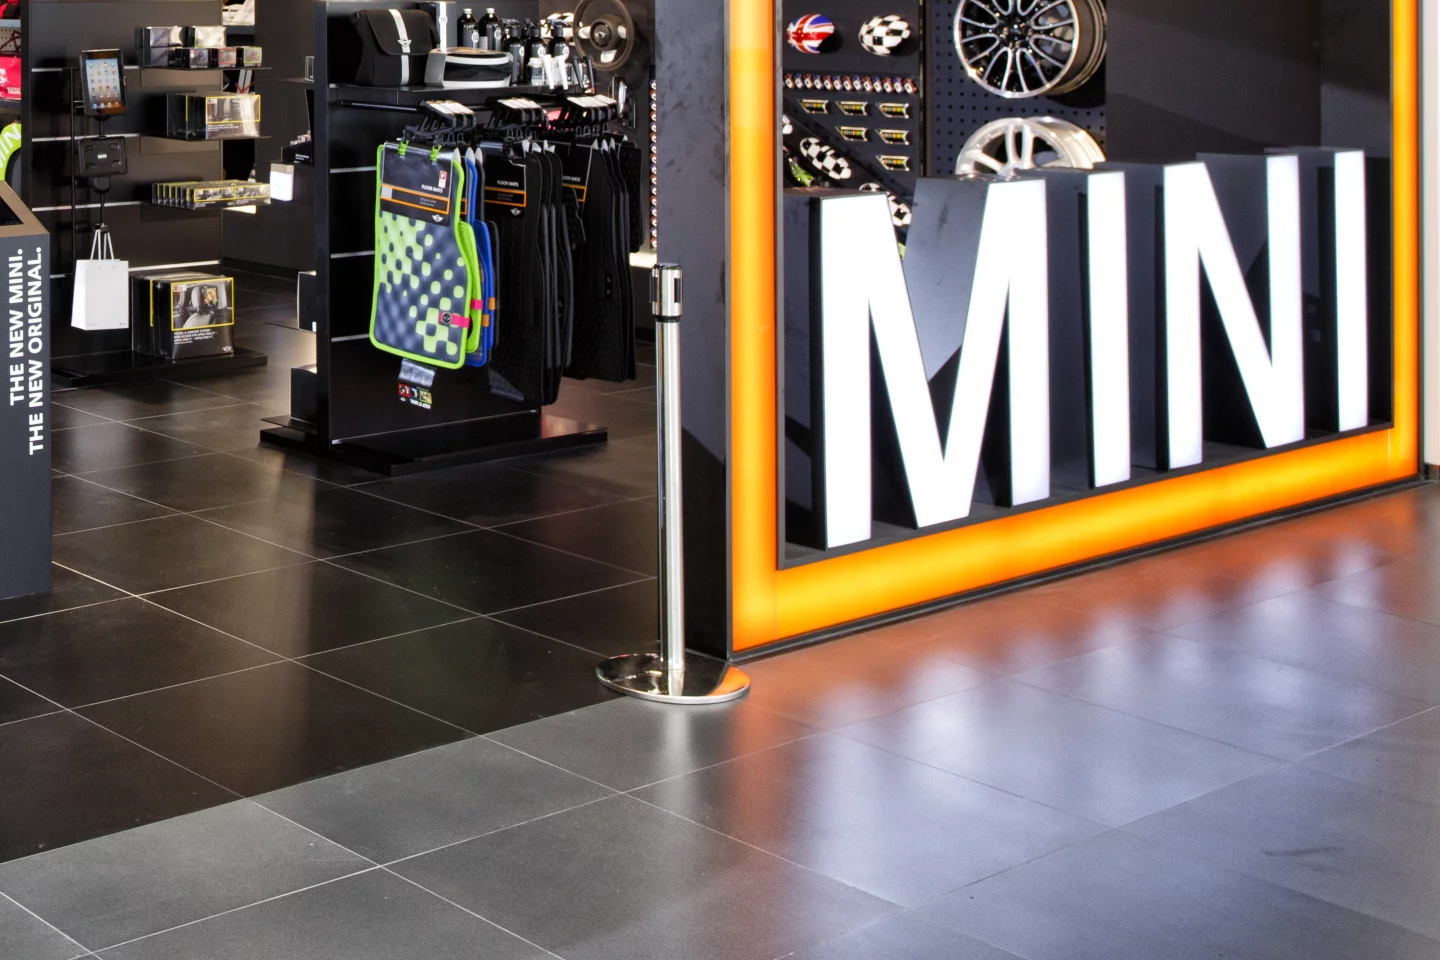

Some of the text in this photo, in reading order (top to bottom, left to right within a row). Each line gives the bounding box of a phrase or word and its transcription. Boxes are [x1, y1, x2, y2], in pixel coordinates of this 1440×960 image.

[8, 248, 25, 406] THE NEW MINI.
[27, 246, 44, 455] THE NEW ORIGINAL.
[821, 150, 1369, 549] MINI
